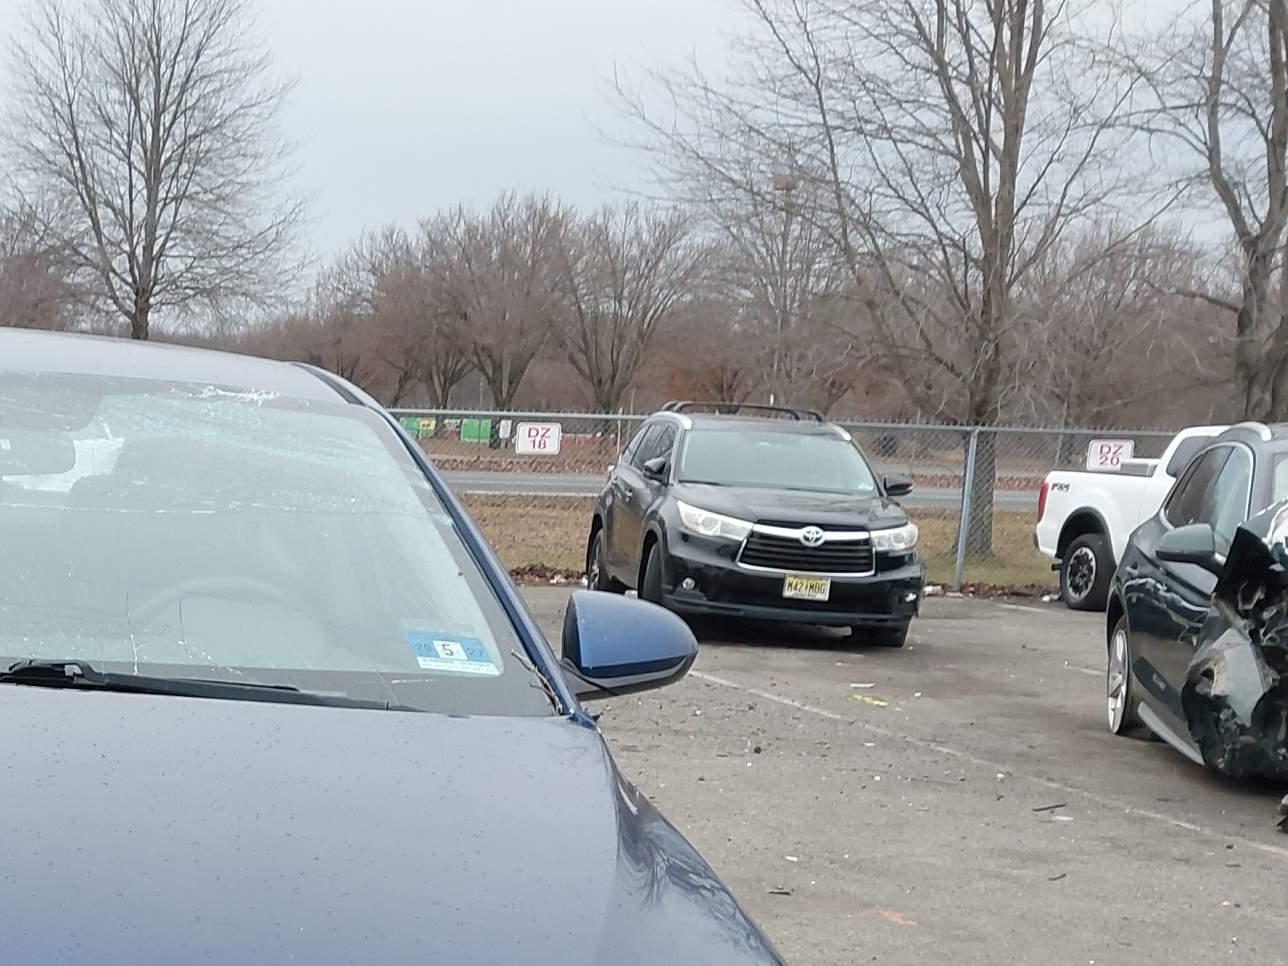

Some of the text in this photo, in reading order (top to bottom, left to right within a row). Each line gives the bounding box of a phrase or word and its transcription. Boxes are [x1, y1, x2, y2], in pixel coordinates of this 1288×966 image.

[528, 427, 551, 438] DZ
[530, 439, 546, 449] 18
[1099, 443, 1124, 455] DZ
[1099, 456, 1120, 466] 20
[442, 643, 454, 656] 5
